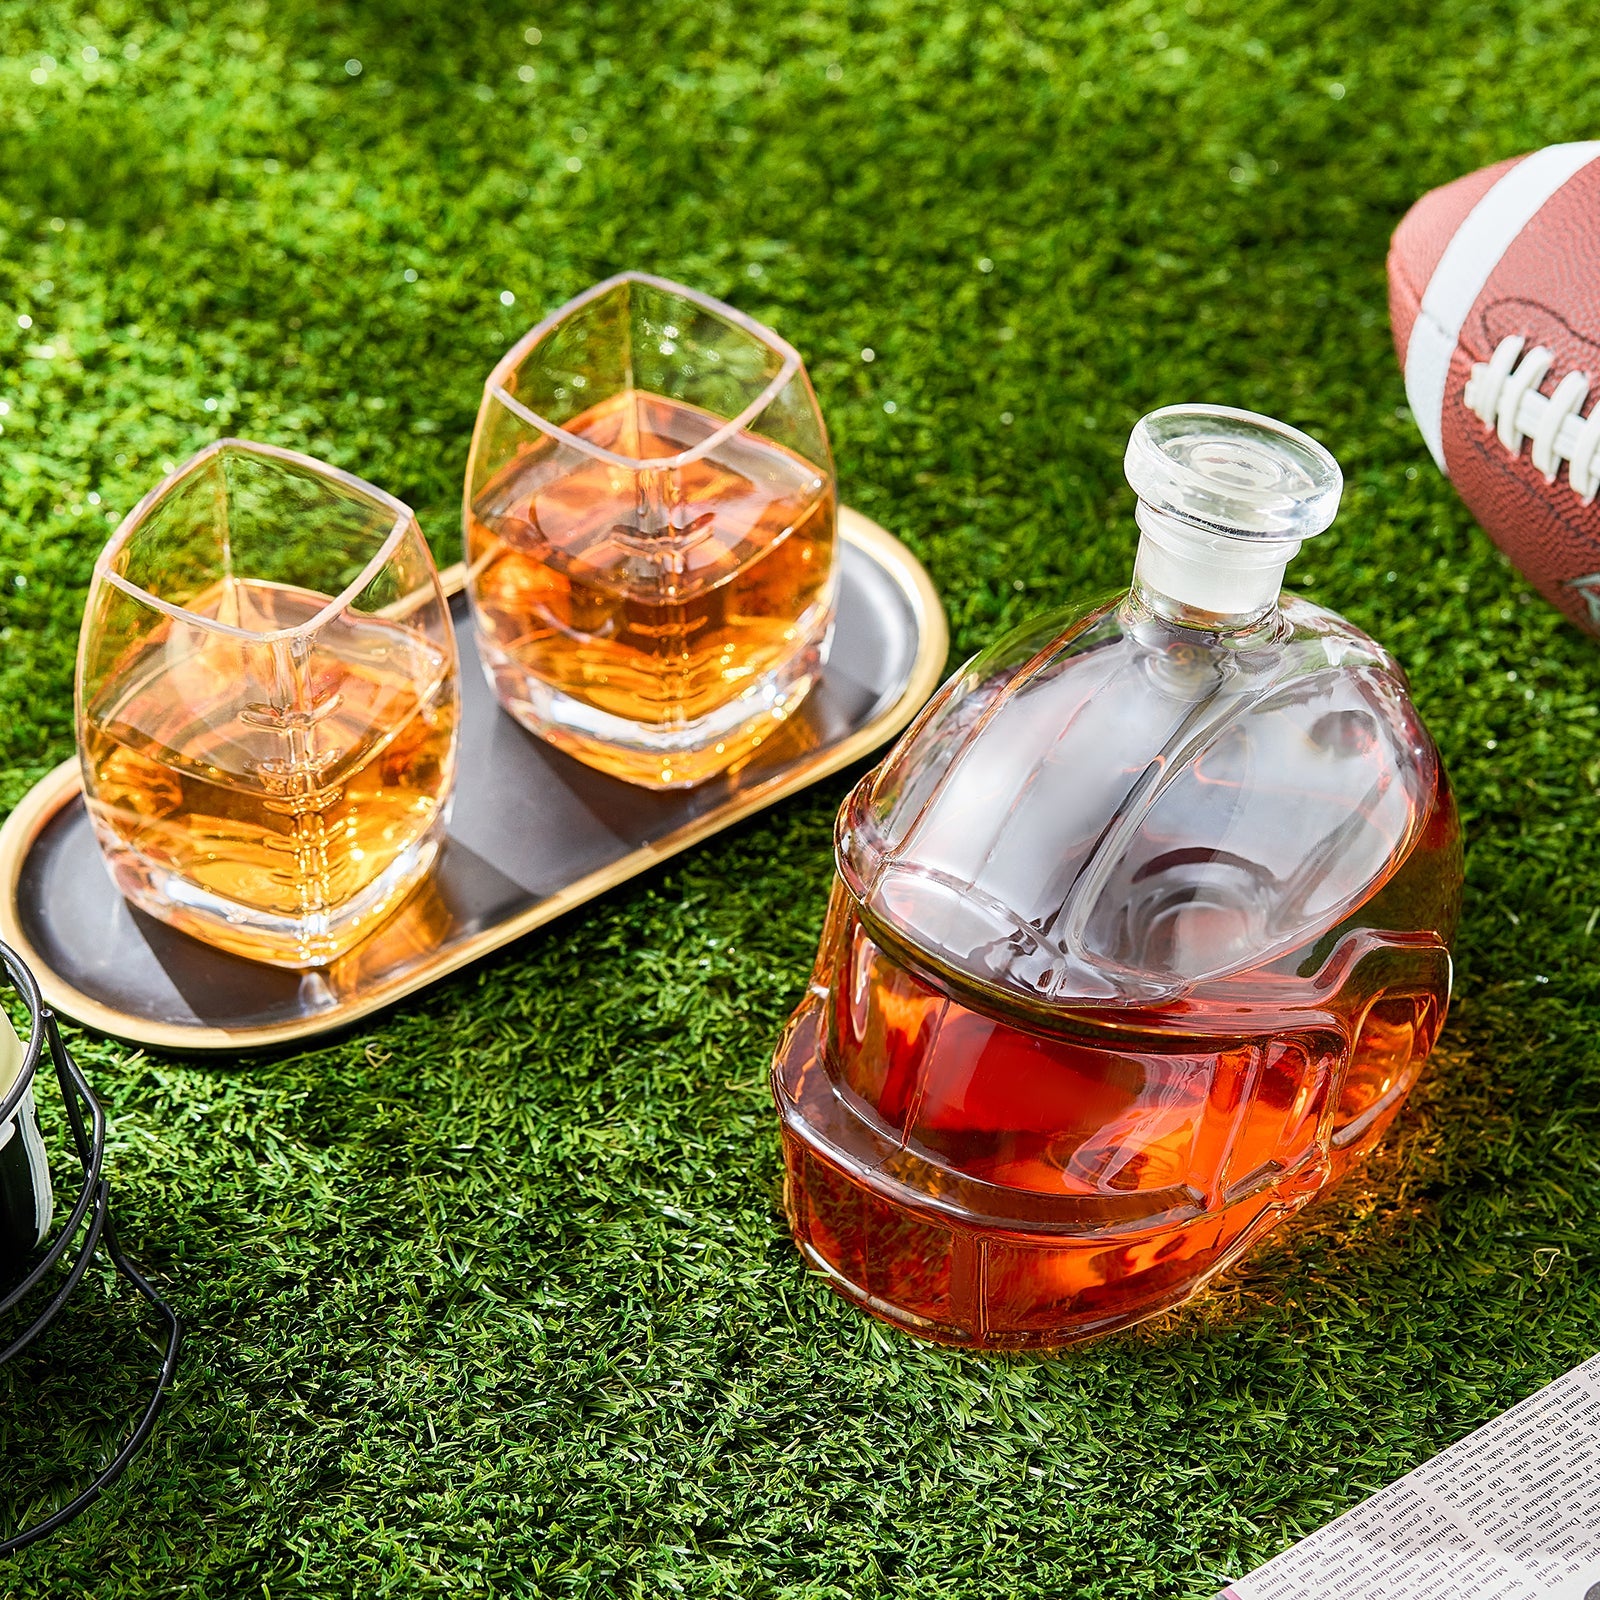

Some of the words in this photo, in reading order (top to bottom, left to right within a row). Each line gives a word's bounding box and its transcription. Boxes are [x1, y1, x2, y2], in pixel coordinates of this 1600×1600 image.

[1587, 1369, 1600, 1382] ay
[1549, 1376, 1572, 1392] store
[1558, 1383, 1582, 1400] most
[1502, 1390, 1550, 1421] concentrate
[1560, 1390, 1591, 1415] ground
[1515, 1396, 1563, 1426] flourishing
[1570, 1412, 1584, 1422] in
[1489, 1419, 1503, 1430] on
[1534, 1411, 1564, 1431] USES
[1504, 1427, 1535, 1448] marble
[1530, 1434, 1552, 1447] The
[1564, 1427, 1584, 1442] 200
[1451, 1441, 1472, 1454] The
[1508, 1442, 1532, 1460] glass
[1532, 1439, 1562, 1460] meters
[1561, 1432, 1600, 1456] Essien's
[1425, 1452, 1453, 1470] lights
[1442, 1457, 1465, 1473] each
[1486, 1457, 1511, 1475] cover
[1565, 1448, 1594, 1469] square
[1412, 1468, 1426, 1478] on
[1458, 1461, 1482, 1478] Here
[1581, 1463, 1594, 1475] of
[1422, 1470, 1445, 1486] class
[1447, 1475, 1460, 1485] is
[1473, 1472, 1487, 1483] on
[1486, 1476, 1505, 1491] 100
[1517, 1472, 1534, 1484] the
[1559, 1470, 1583, 1487] three
[1575, 1478, 1595, 1491] was
[1388, 1480, 1407, 1496] and
[1432, 1482, 1449, 1494] the
[1560, 1488, 1578, 1501] one
[1365, 1491, 1390, 1509] north
[1381, 1488, 1419, 1512] longing
[1442, 1490, 1459, 1503] the
[1500, 1494, 1521, 1510] says
[1549, 1498, 1562, 1510] of
[1349, 1506, 1367, 1521] and
[1388, 1496, 1427, 1525] romantic
[1424, 1505, 1436, 1518] of
[1565, 1500, 1582, 1512] the
[1578, 1500, 1600, 1517] tion.
[1368, 1510, 1385, 1523] for
[1431, 1513, 1448, 1526] for
[1473, 1510, 1499, 1529] victor
[1507, 1510, 1519, 1520] A
[1513, 1504, 1554, 1531] Europe's
[1535, 1510, 1563, 1532] gothic
[1325, 1516, 1351, 1534] south
[1352, 1520, 1370, 1532] the
[1387, 1512, 1423, 1541] graceful
[1415, 1524, 1432, 1537] the
[1483, 1515, 1509, 1537] group
[1532, 1516, 1582, 1549] Downtown
[1315, 1532, 1327, 1542] of
[1357, 1525, 1386, 1545] tender
[1418, 1522, 1459, 1549] building
[1447, 1532, 1469, 1546] The
[1492, 1528, 1516, 1546] most
[1502, 1532, 1533, 1554] church
[1300, 1538, 1317, 1550] the
[1366, 1539, 1387, 1555] mist
[1389, 1535, 1415, 1555] small
[1458, 1539, 1476, 1553] one
[1544, 1534, 1575, 1555] during
[1561, 1538, 1592, 1562] second
[1280, 1548, 1303, 1565] kind
[1297, 1548, 1326, 1567] Milan
[1319, 1544, 1355, 1567] feelings
[1347, 1553, 1365, 1568] and
[1371, 1553, 1389, 1567] and
[1423, 1546, 1445, 1562] 14th
[1447, 1552, 1458, 1563] of
[1513, 1546, 1534, 1562] club
[1579, 1546, 1600, 1563] pril,
[1269, 1561, 1281, 1571] of
[1285, 1565, 1299, 1574] in
[1370, 1546, 1422, 1582] construction
[1446, 1547, 1488, 1579] industrial
[1475, 1556, 1496, 1573] each
[1524, 1558, 1540, 1571] the
[1533, 1561, 1560, 1581] world
[1564, 1562, 1580, 1574] the
[1297, 1568, 1315, 1584] and
[1332, 1564, 1373, 1592] beautiful
[1388, 1563, 1420, 1587] century
[1408, 1560, 1448, 1587] Europe's
[1459, 1571, 1475, 1584] the
[1544, 1573, 1564, 1588] first
[1254, 1572, 1287, 1595] Europe
[1386, 1586, 1409, 1600] mos
